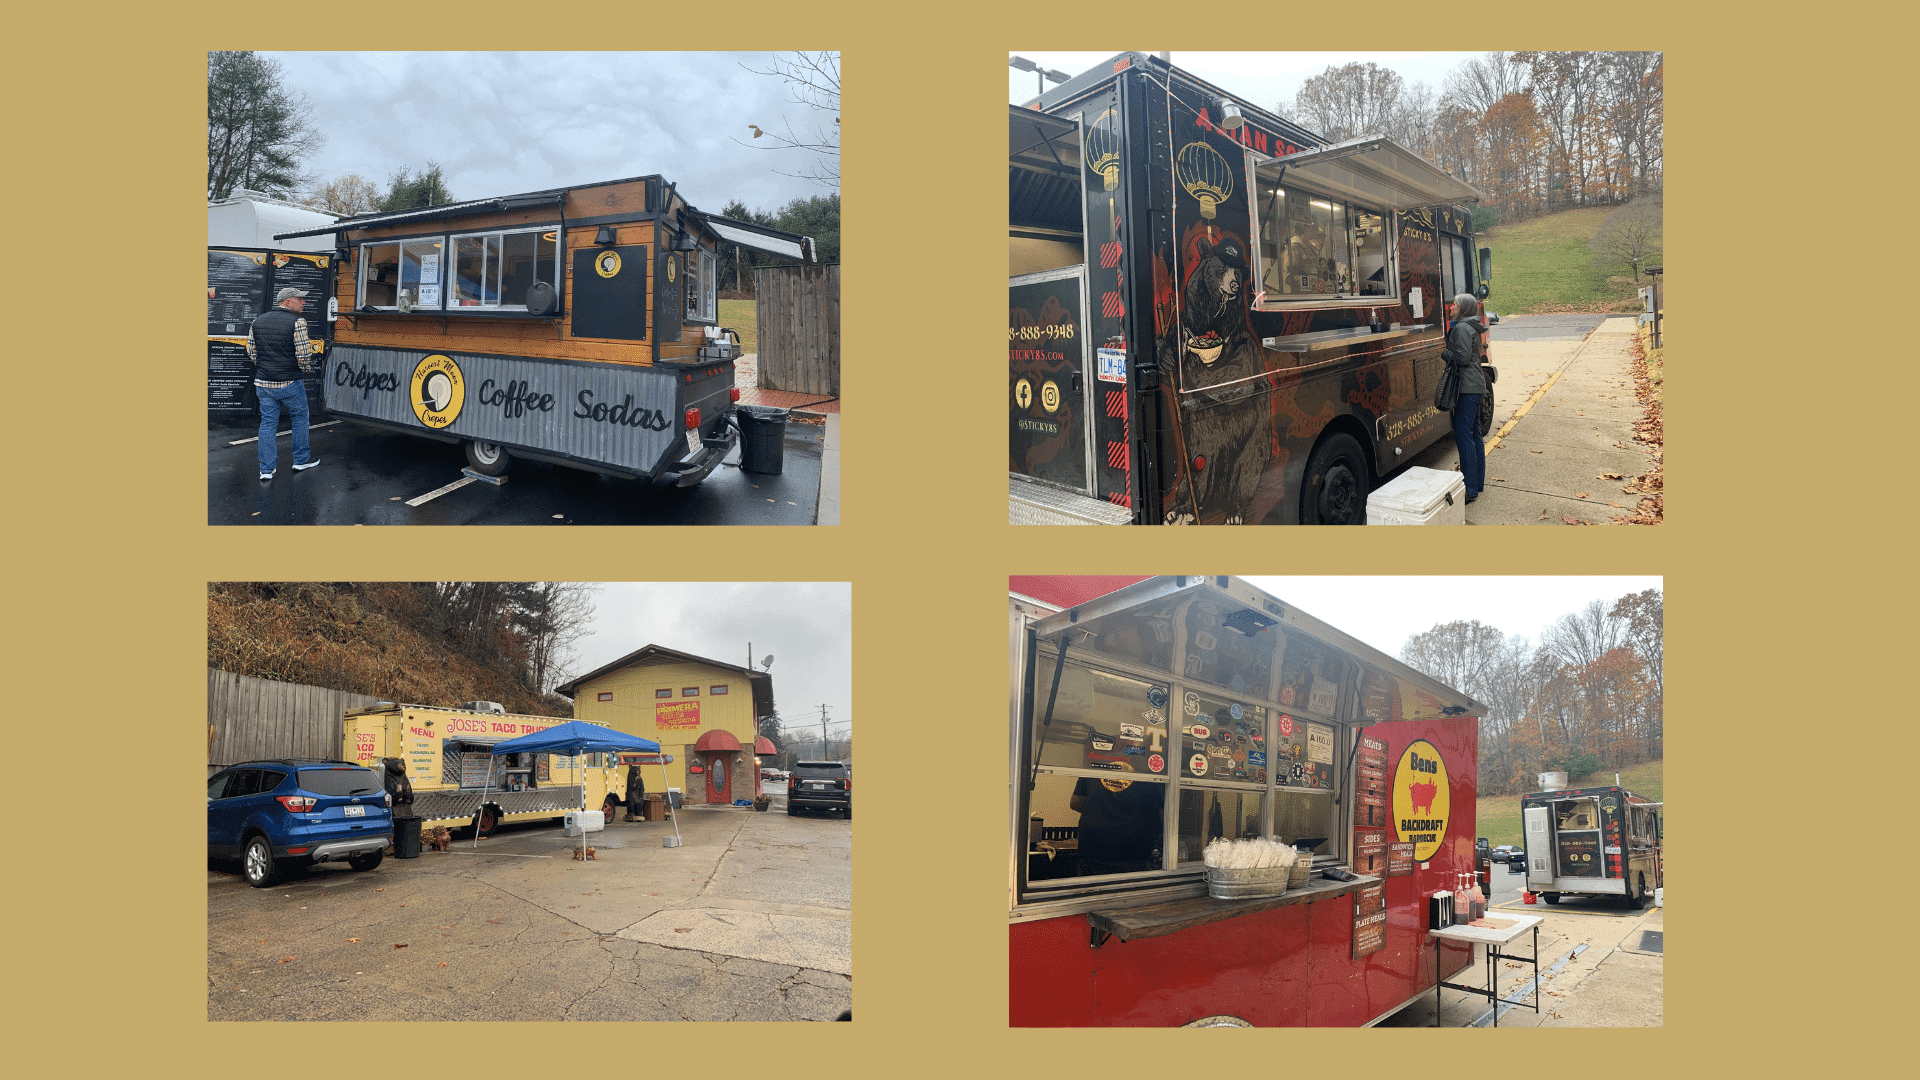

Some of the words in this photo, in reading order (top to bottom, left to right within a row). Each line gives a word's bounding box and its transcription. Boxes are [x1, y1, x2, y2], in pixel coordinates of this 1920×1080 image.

[1274, 140, 1302, 157] SO
[1009, 350, 1065, 361] TICKY8S.COM
[479, 379, 556, 419] Coffee
[573, 389, 672, 432] Sodas
[410, 726, 435, 739] MENU
[447, 718, 487, 733] JOSE'S
[491, 722, 517, 734] TACO
[520, 724, 550, 735] TRU
[1364, 738, 1382, 750] MEATS
[1401, 819, 1443, 831] BACKDRAFT
[1408, 834, 1437, 842] BARBECUE
[1400, 850, 1413, 858] MEALS
[1355, 916, 1370, 929] PLATE
[1370, 912, 1386, 924] MEALS
